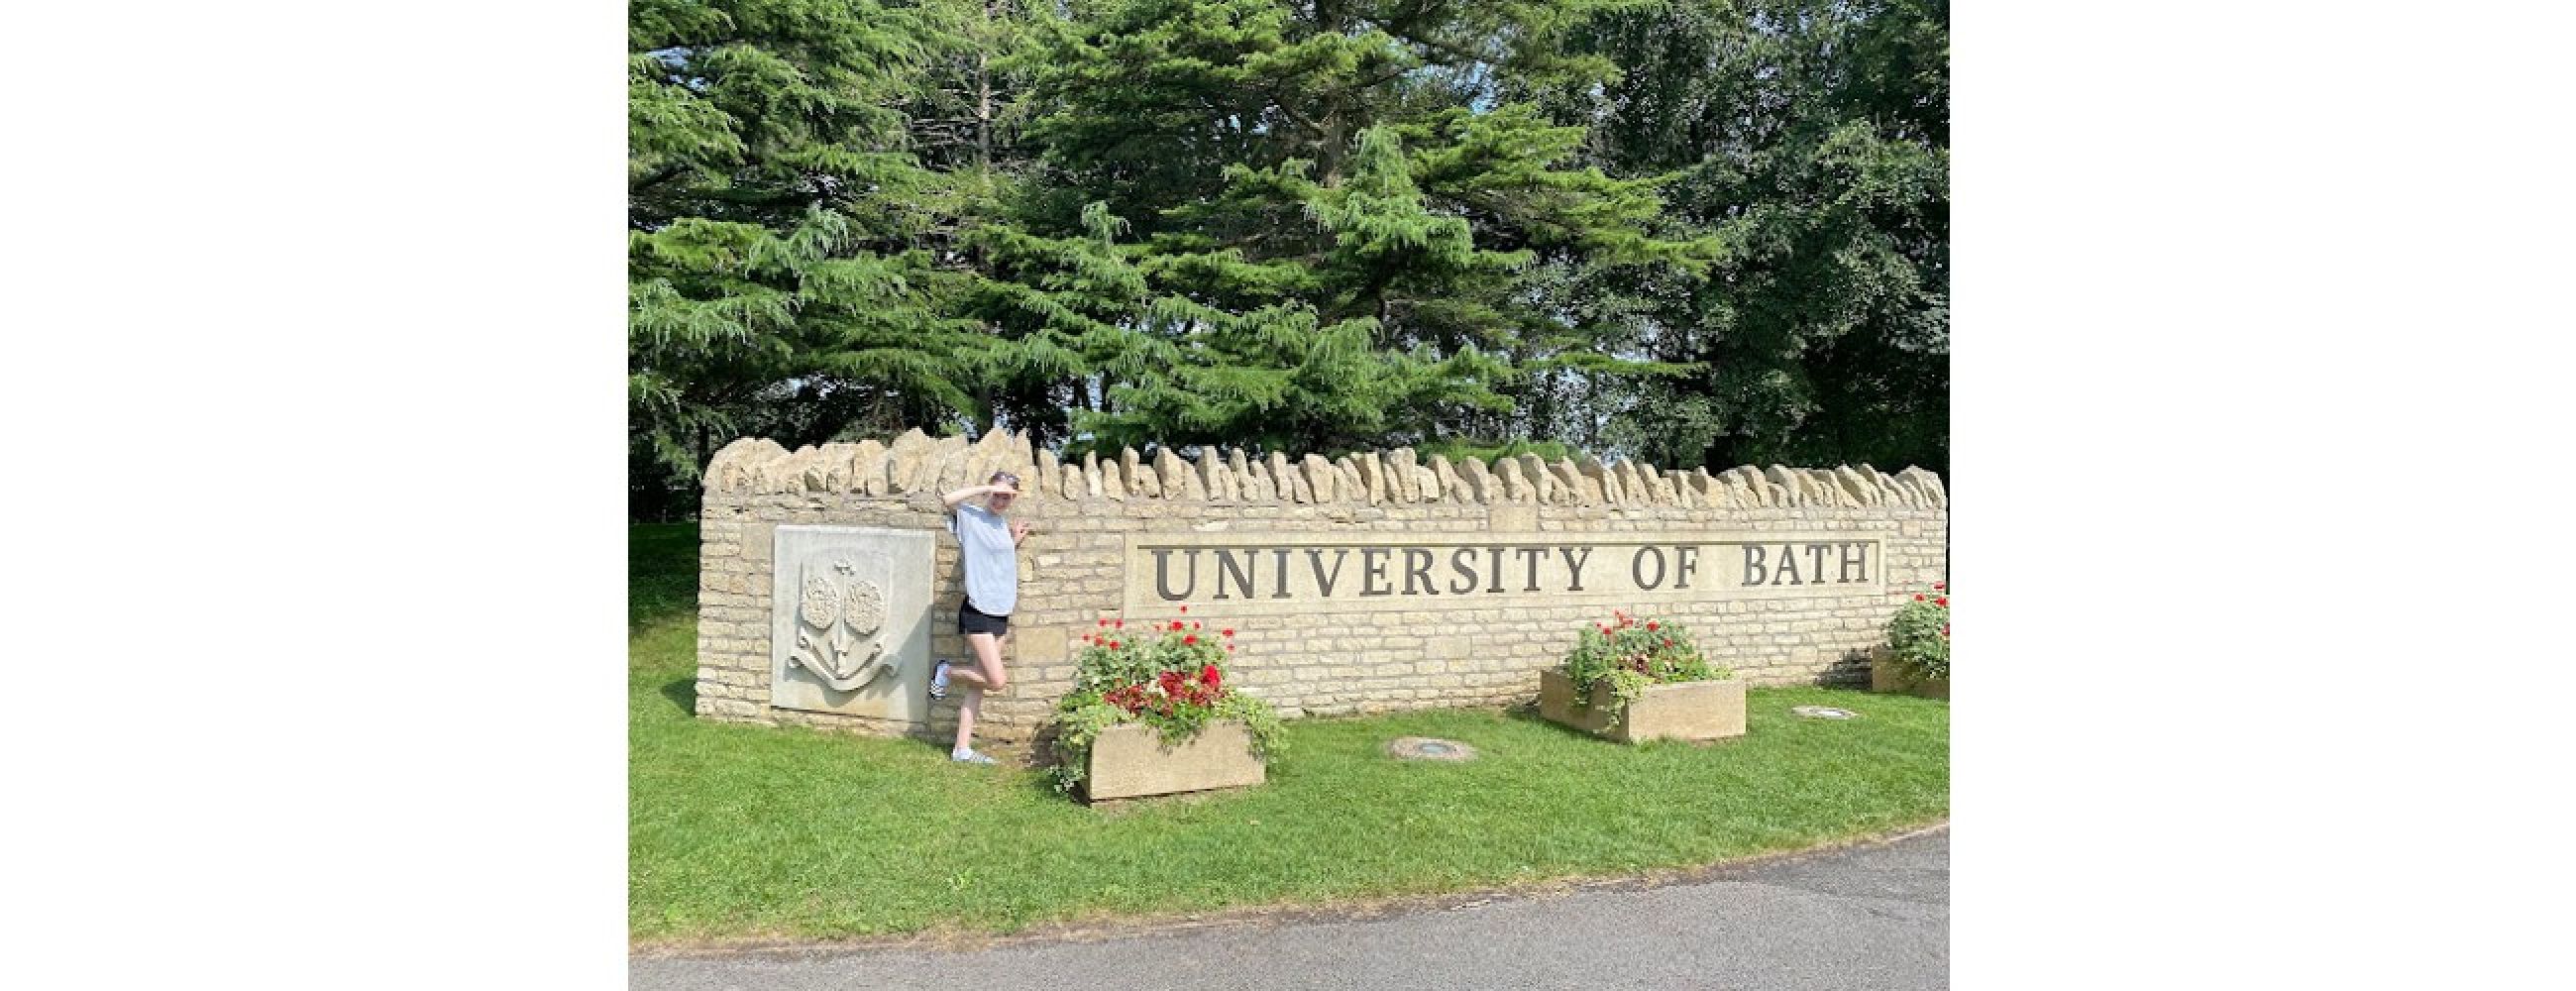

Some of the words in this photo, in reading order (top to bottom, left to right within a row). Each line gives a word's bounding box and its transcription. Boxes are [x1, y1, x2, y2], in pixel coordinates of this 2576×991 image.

[1150, 547, 1593, 601] UNIVERSITY
[1632, 545, 1699, 590] OF
[1741, 543, 1870, 587] BATH
